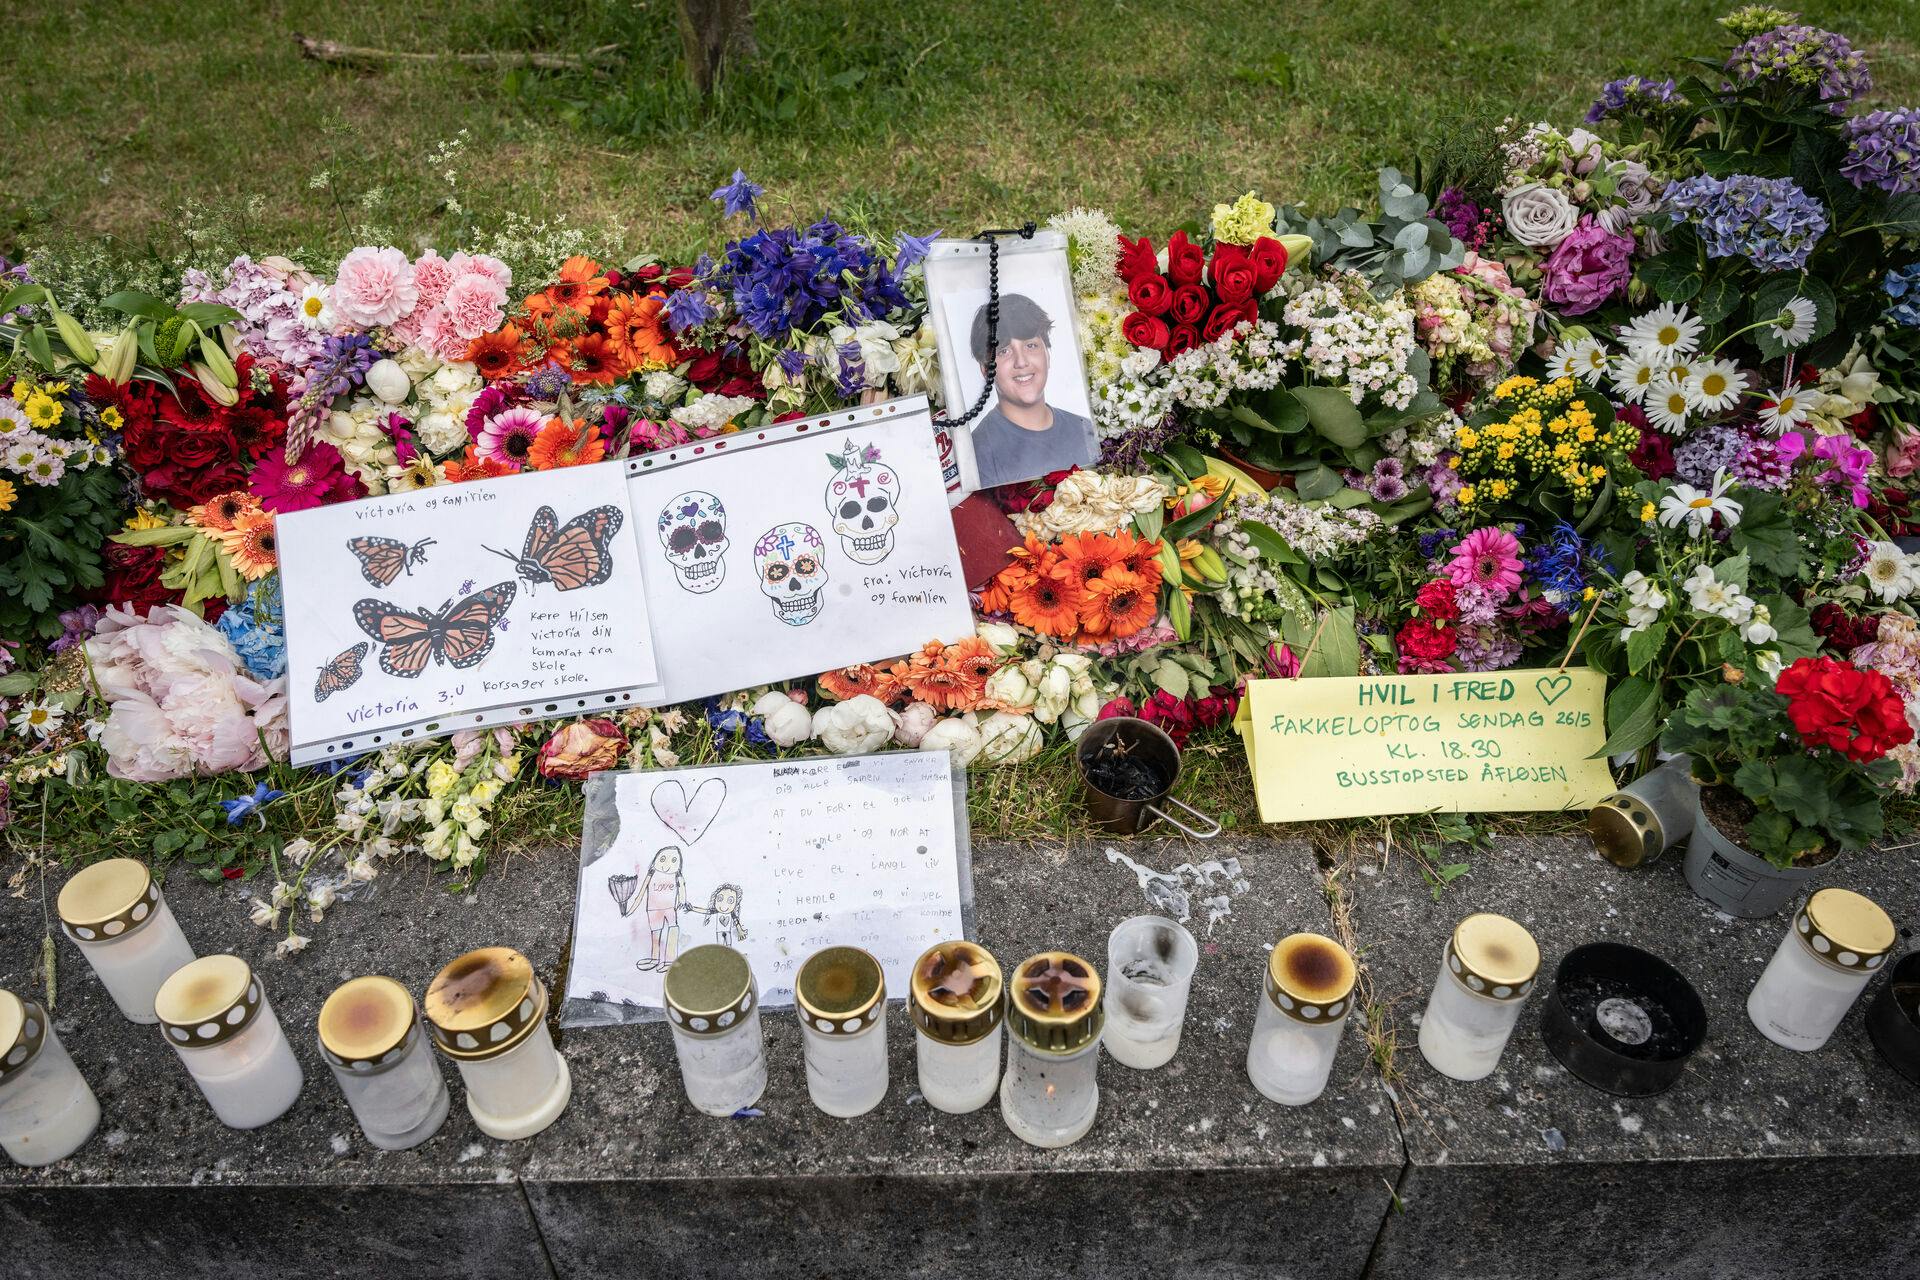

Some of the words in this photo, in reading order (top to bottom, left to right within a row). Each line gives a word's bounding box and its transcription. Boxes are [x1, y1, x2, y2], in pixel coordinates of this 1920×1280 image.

[425, 500, 438, 509] og
[871, 593, 886, 606] og
[1358, 683, 1416, 706] HVIL
[1433, 683, 1439, 703] I
[1447, 678, 1515, 701] FRED
[1270, 713, 1440, 736] FAKKELOPTOG
[1555, 711, 1591, 728] 26/5
[1440, 739, 1501, 760] 18.30
[1336, 768, 1468, 788] BUSSTOPSTED
[1481, 762, 1568, 783] ÅFLØJEN
